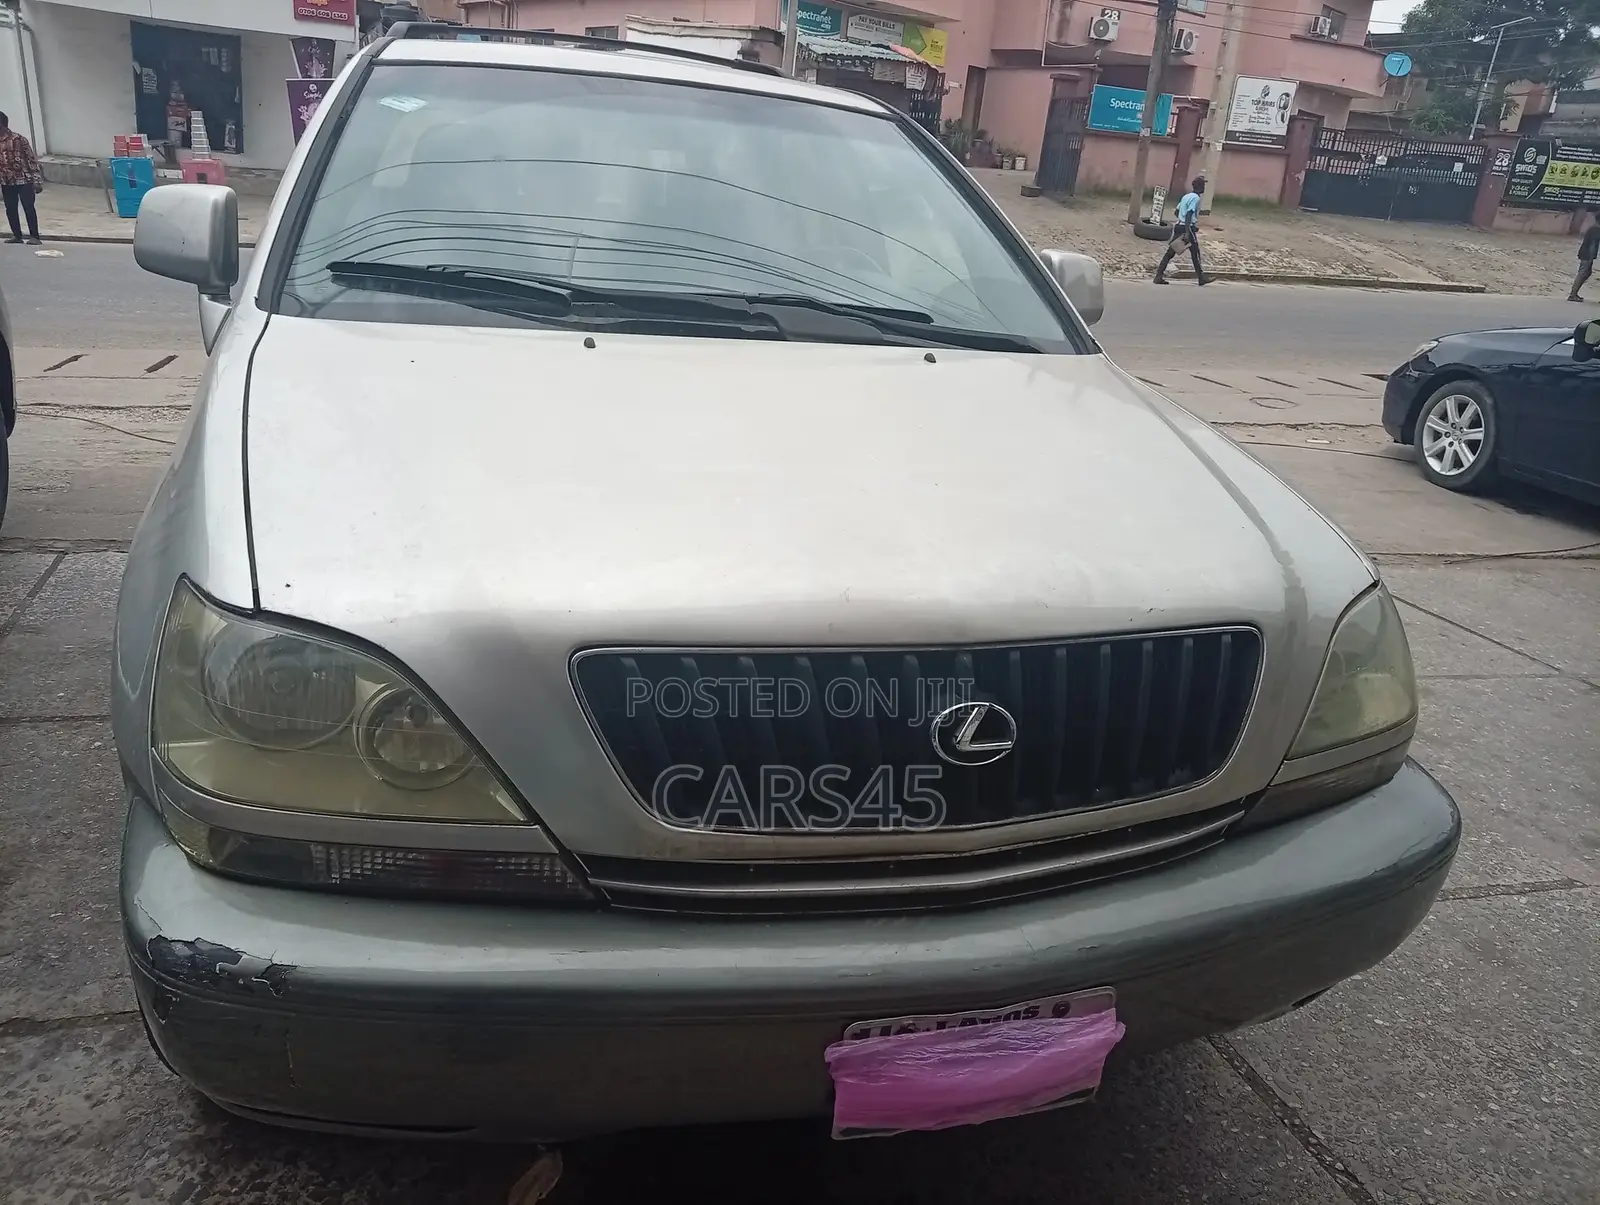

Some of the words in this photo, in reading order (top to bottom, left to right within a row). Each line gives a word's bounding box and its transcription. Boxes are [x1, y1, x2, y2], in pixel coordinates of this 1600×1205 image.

[796, 10, 831, 24] pectranet
[1104, 10, 1118, 20] 28
[882, 21, 895, 30] BILLS
[1110, 98, 1146, 111] Spectran
[1495, 152, 1511, 167] 28
